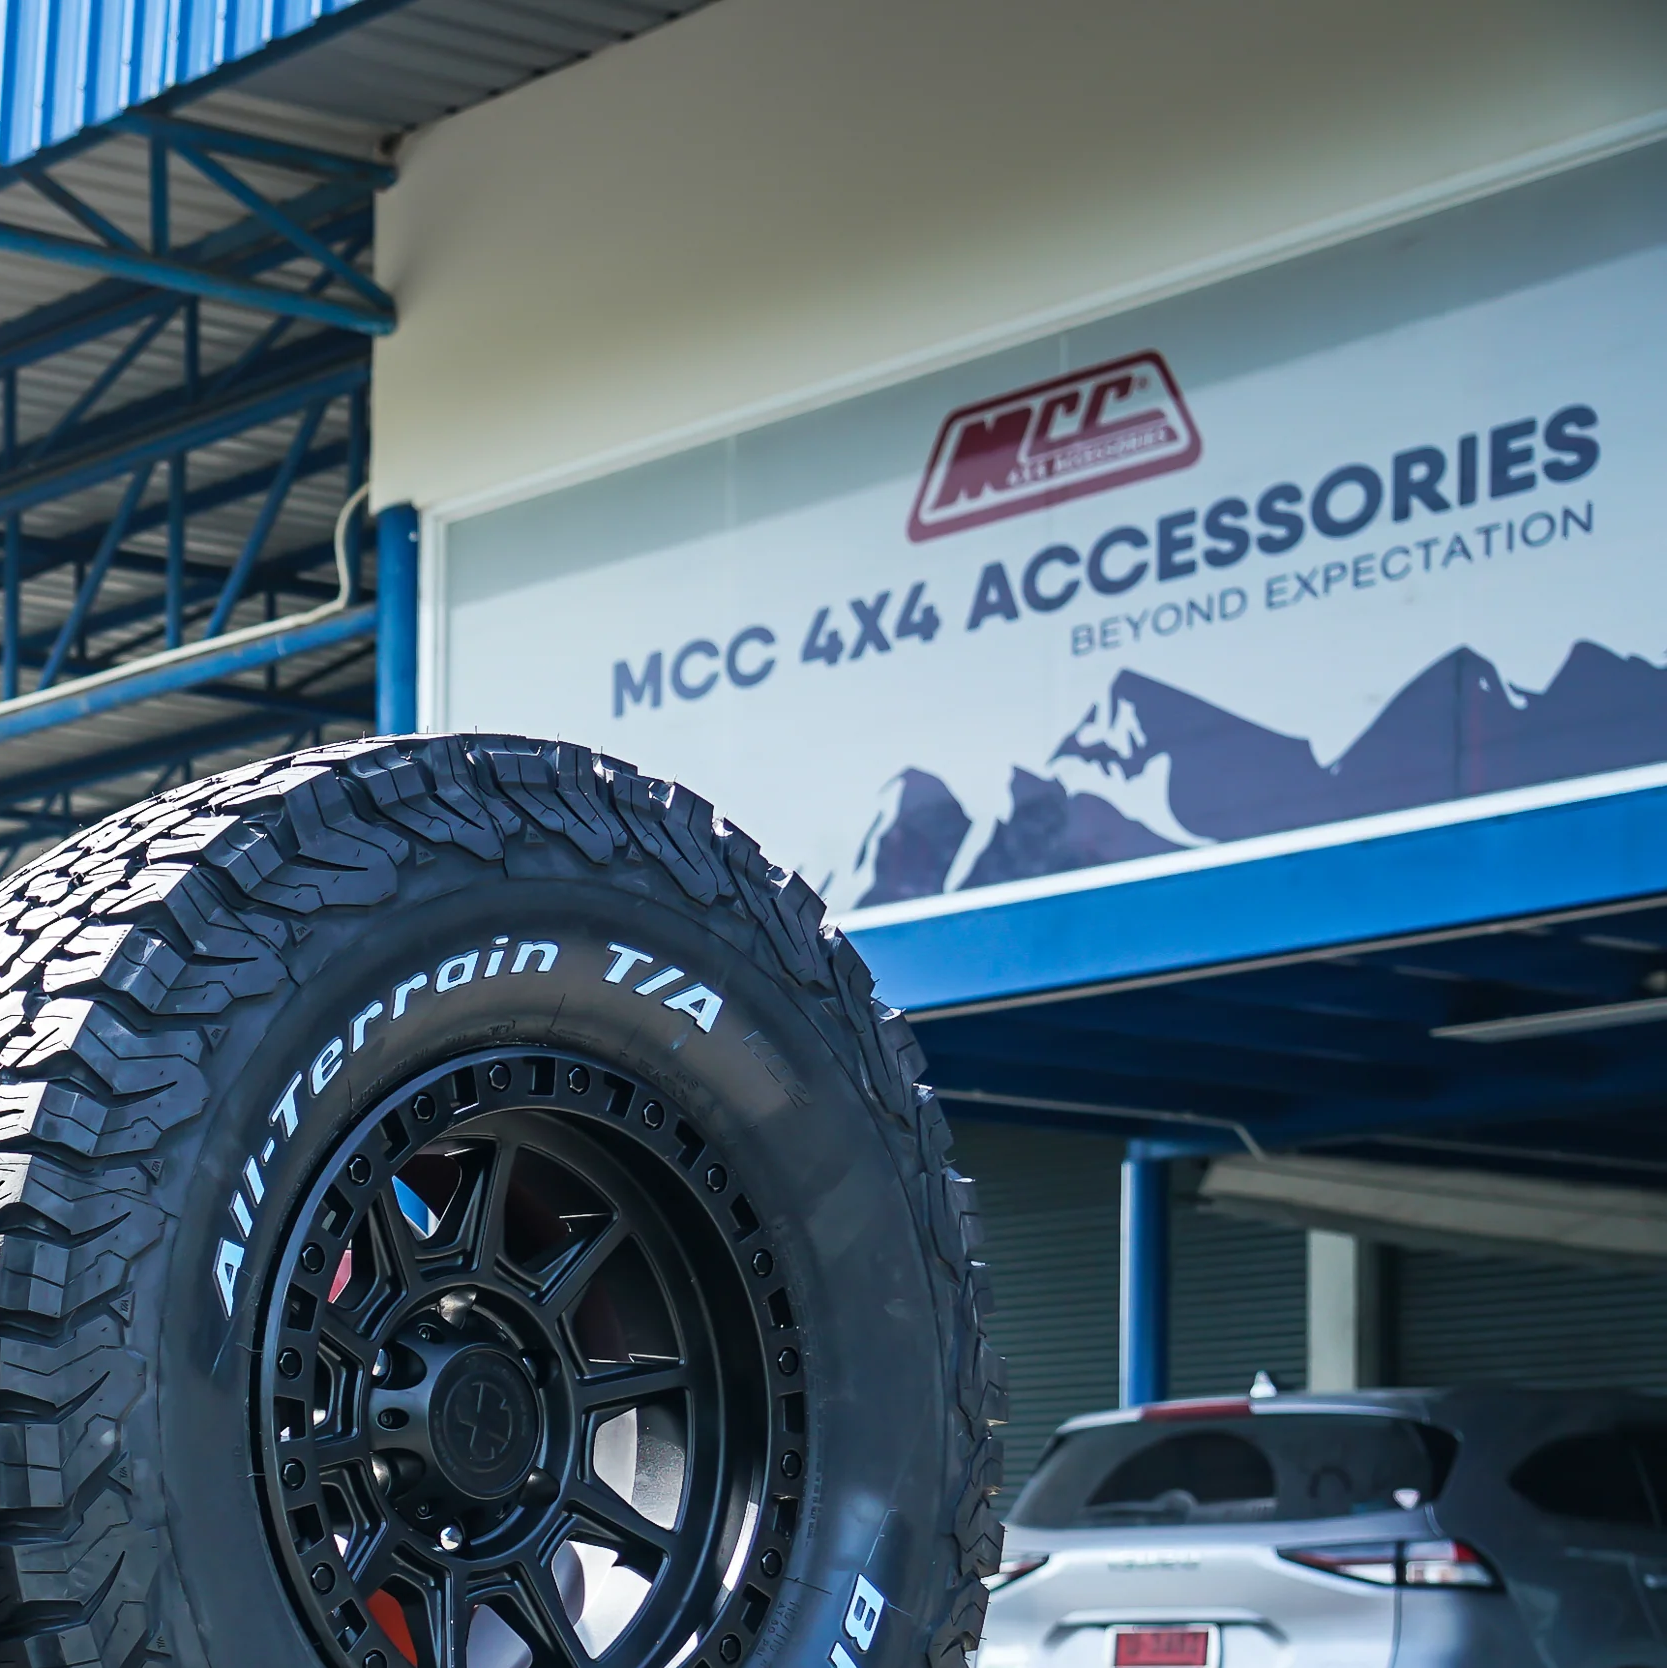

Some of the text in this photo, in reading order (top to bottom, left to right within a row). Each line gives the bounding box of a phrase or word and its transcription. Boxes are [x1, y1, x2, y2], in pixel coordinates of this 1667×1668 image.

[930, 375, 1166, 510] MCC
[611, 404, 1601, 718] MCC 4X4 ACCESSORIES
[1070, 500, 1598, 658] BEYOND EXPECTATION
[214, 936, 727, 1321] All-Terrain T/A
